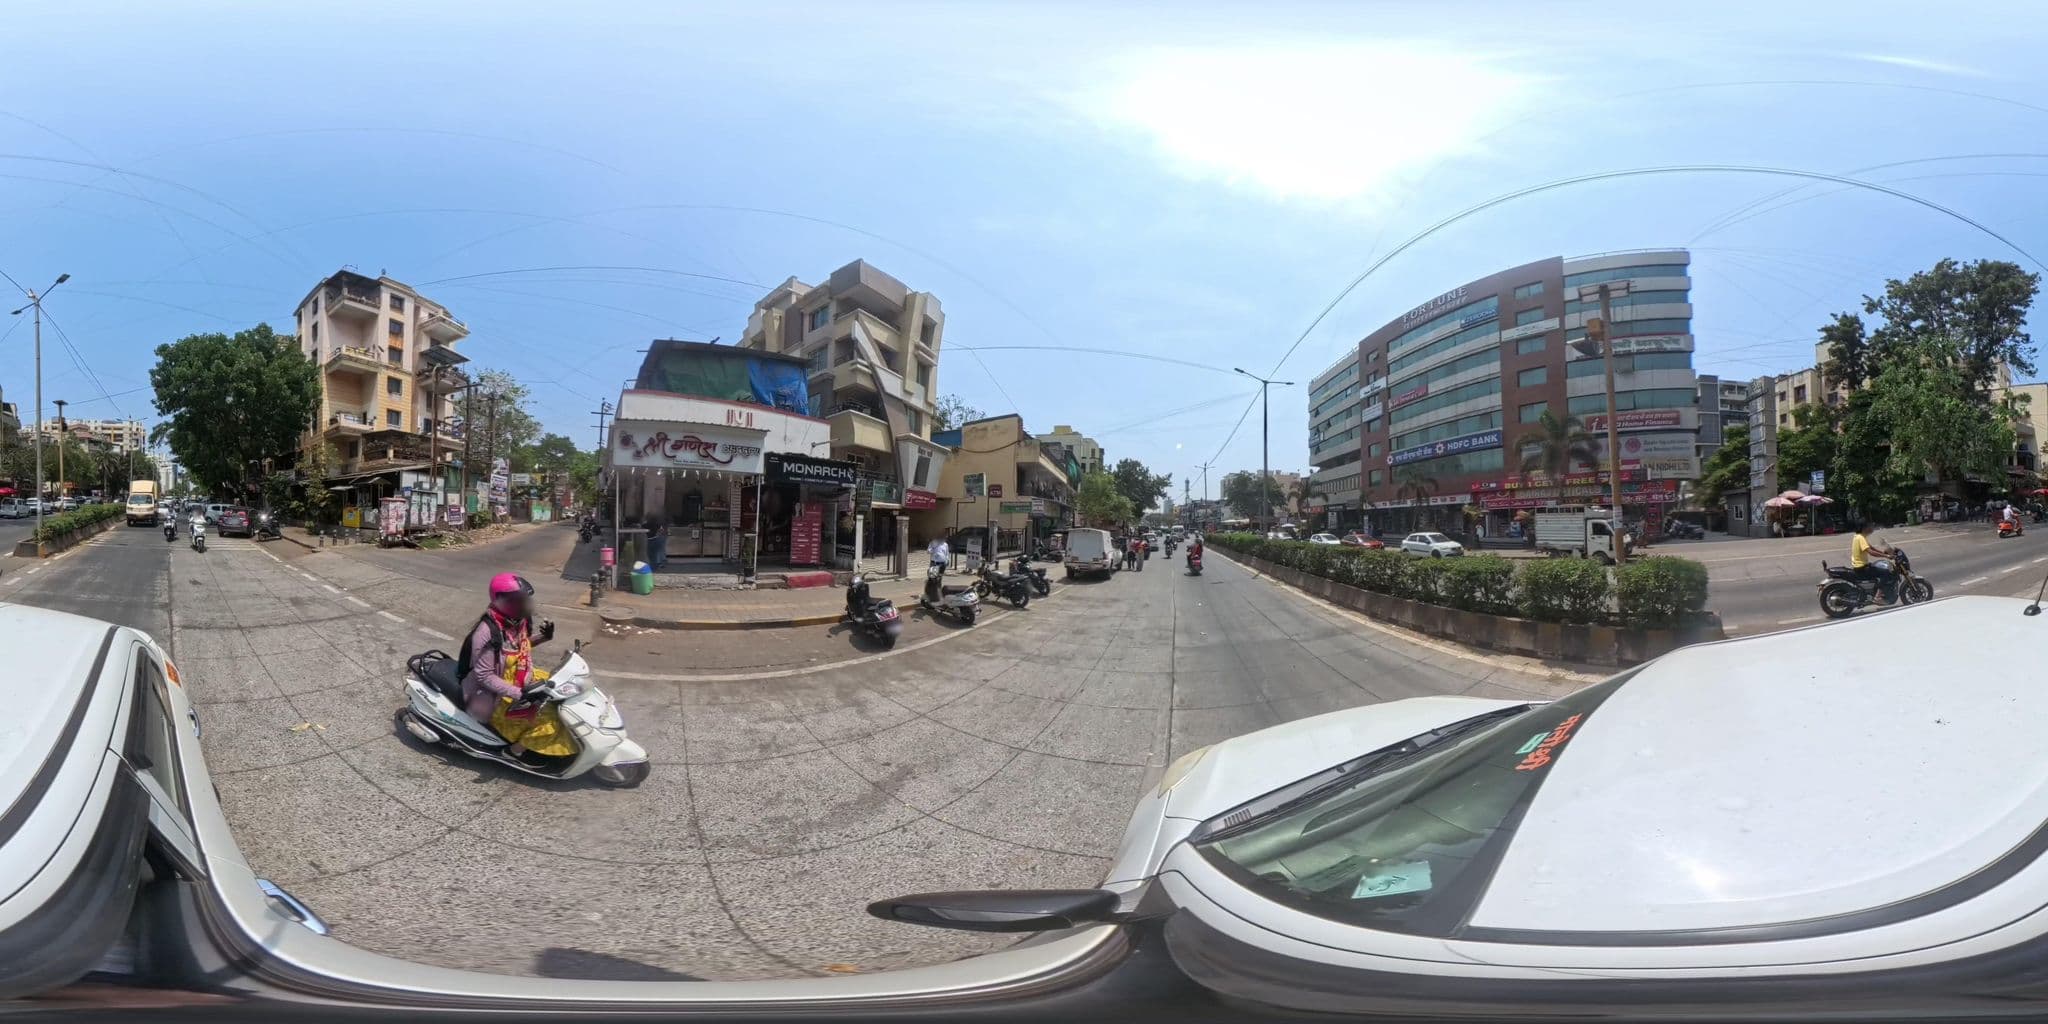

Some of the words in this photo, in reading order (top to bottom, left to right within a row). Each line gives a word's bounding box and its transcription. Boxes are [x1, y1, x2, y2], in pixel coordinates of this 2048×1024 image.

[1403, 286, 1468, 322] FORTUNE
[643, 432, 676, 459] श्री
[671, 435, 734, 464] गणेश
[1447, 439, 1470, 451] HDFC
[1472, 434, 1498, 446] BANK
[783, 462, 847, 478] MONARCH
[1566, 477, 1595, 485] FREE
